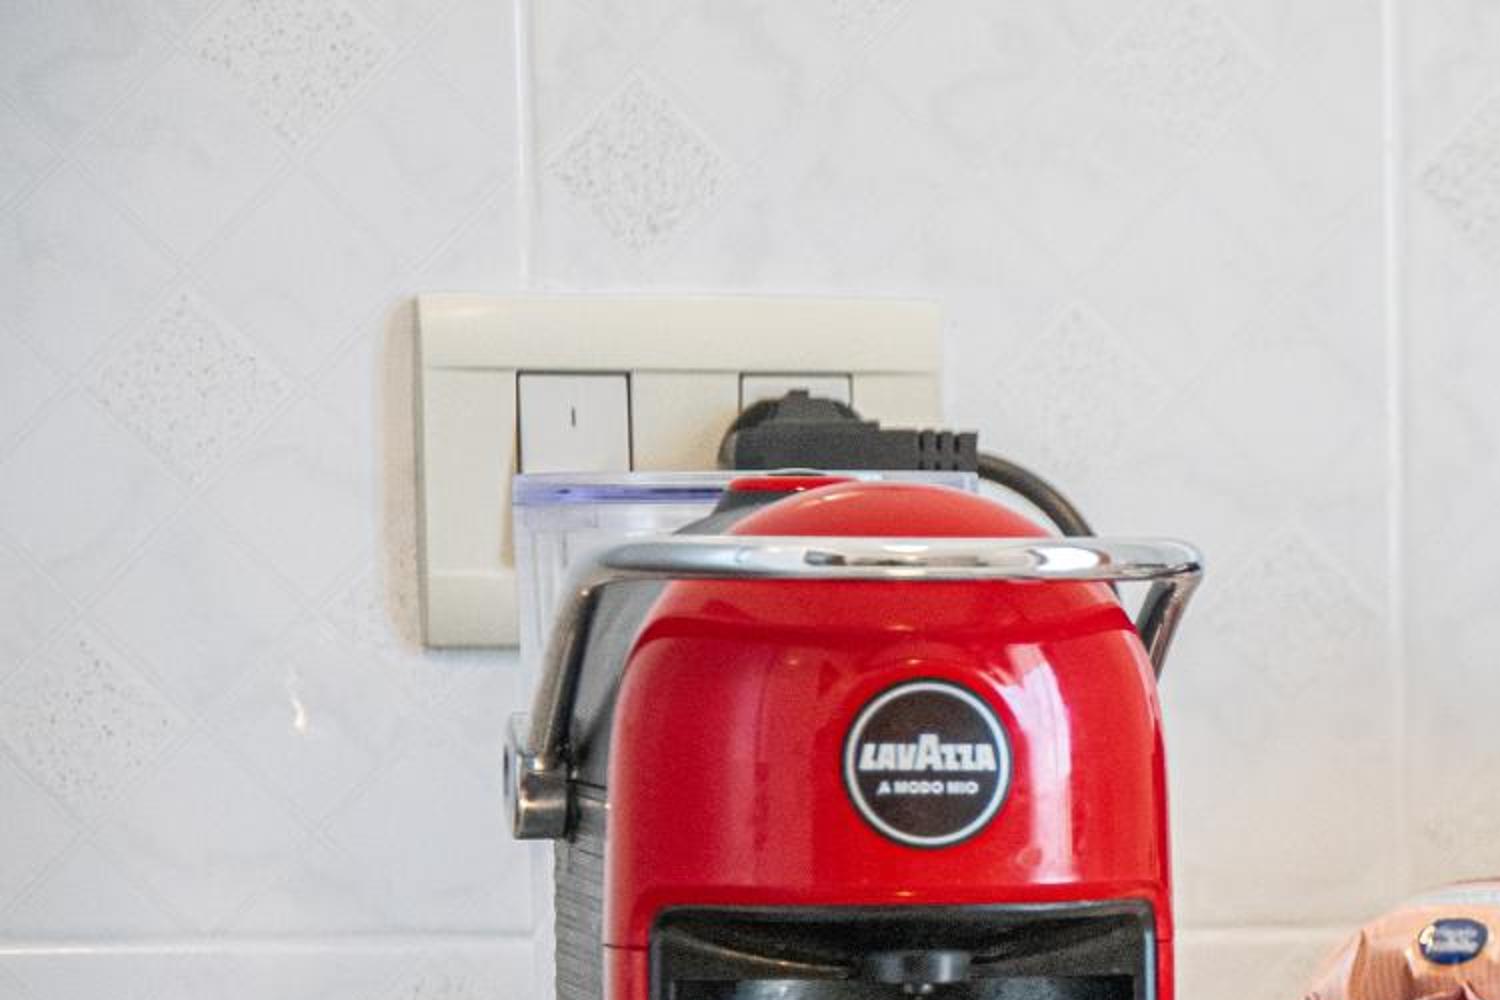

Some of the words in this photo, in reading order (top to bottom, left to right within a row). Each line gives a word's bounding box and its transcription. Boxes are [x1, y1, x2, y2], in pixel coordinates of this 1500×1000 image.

[859, 733, 997, 771] LAVAZZA
[877, 780, 891, 795] A
[894, 780, 944, 795] MODO
[947, 780, 979, 795] MIO
